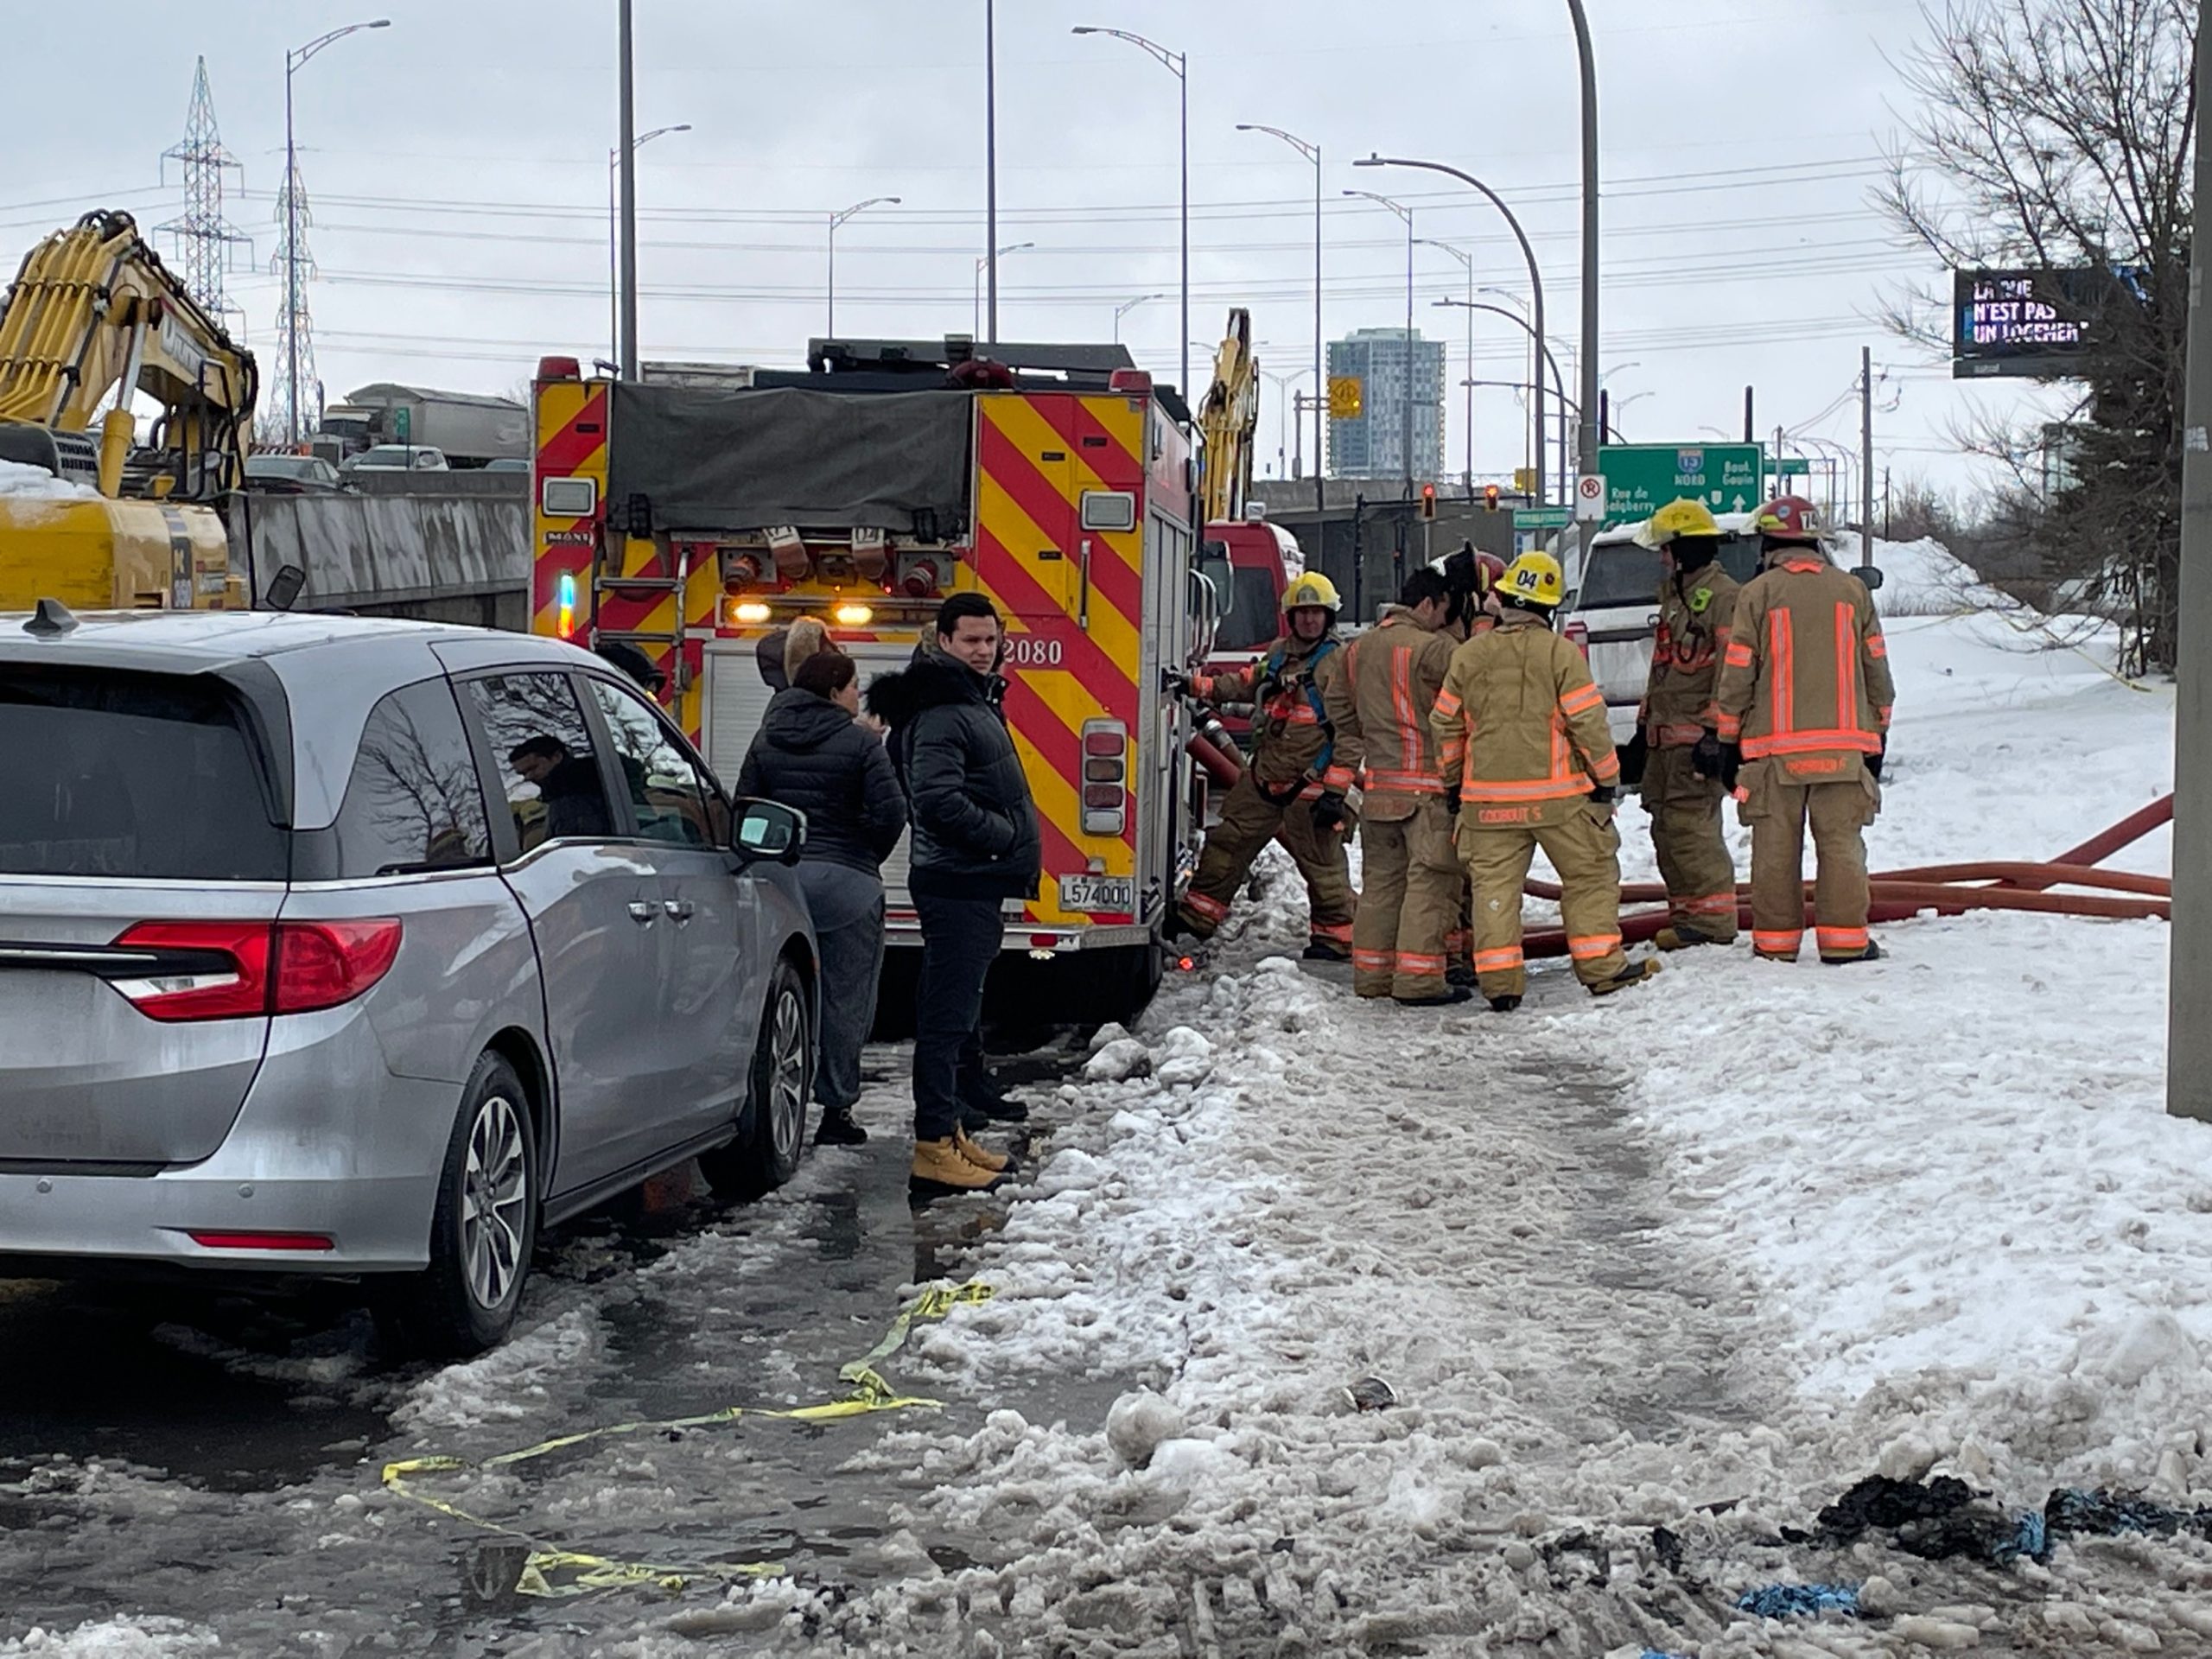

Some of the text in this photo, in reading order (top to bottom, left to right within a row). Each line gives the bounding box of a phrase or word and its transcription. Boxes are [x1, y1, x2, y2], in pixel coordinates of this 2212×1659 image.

[1974, 302, 2056, 321] N'EST PAS
[1974, 324, 1997, 343] UN
[1675, 474, 1706, 486] NORD
[1611, 486, 1649, 499] Rue de
[1516, 569, 1538, 589] 04
[1003, 639, 1062, 664] 2080
[1062, 885, 1130, 905] L574000
